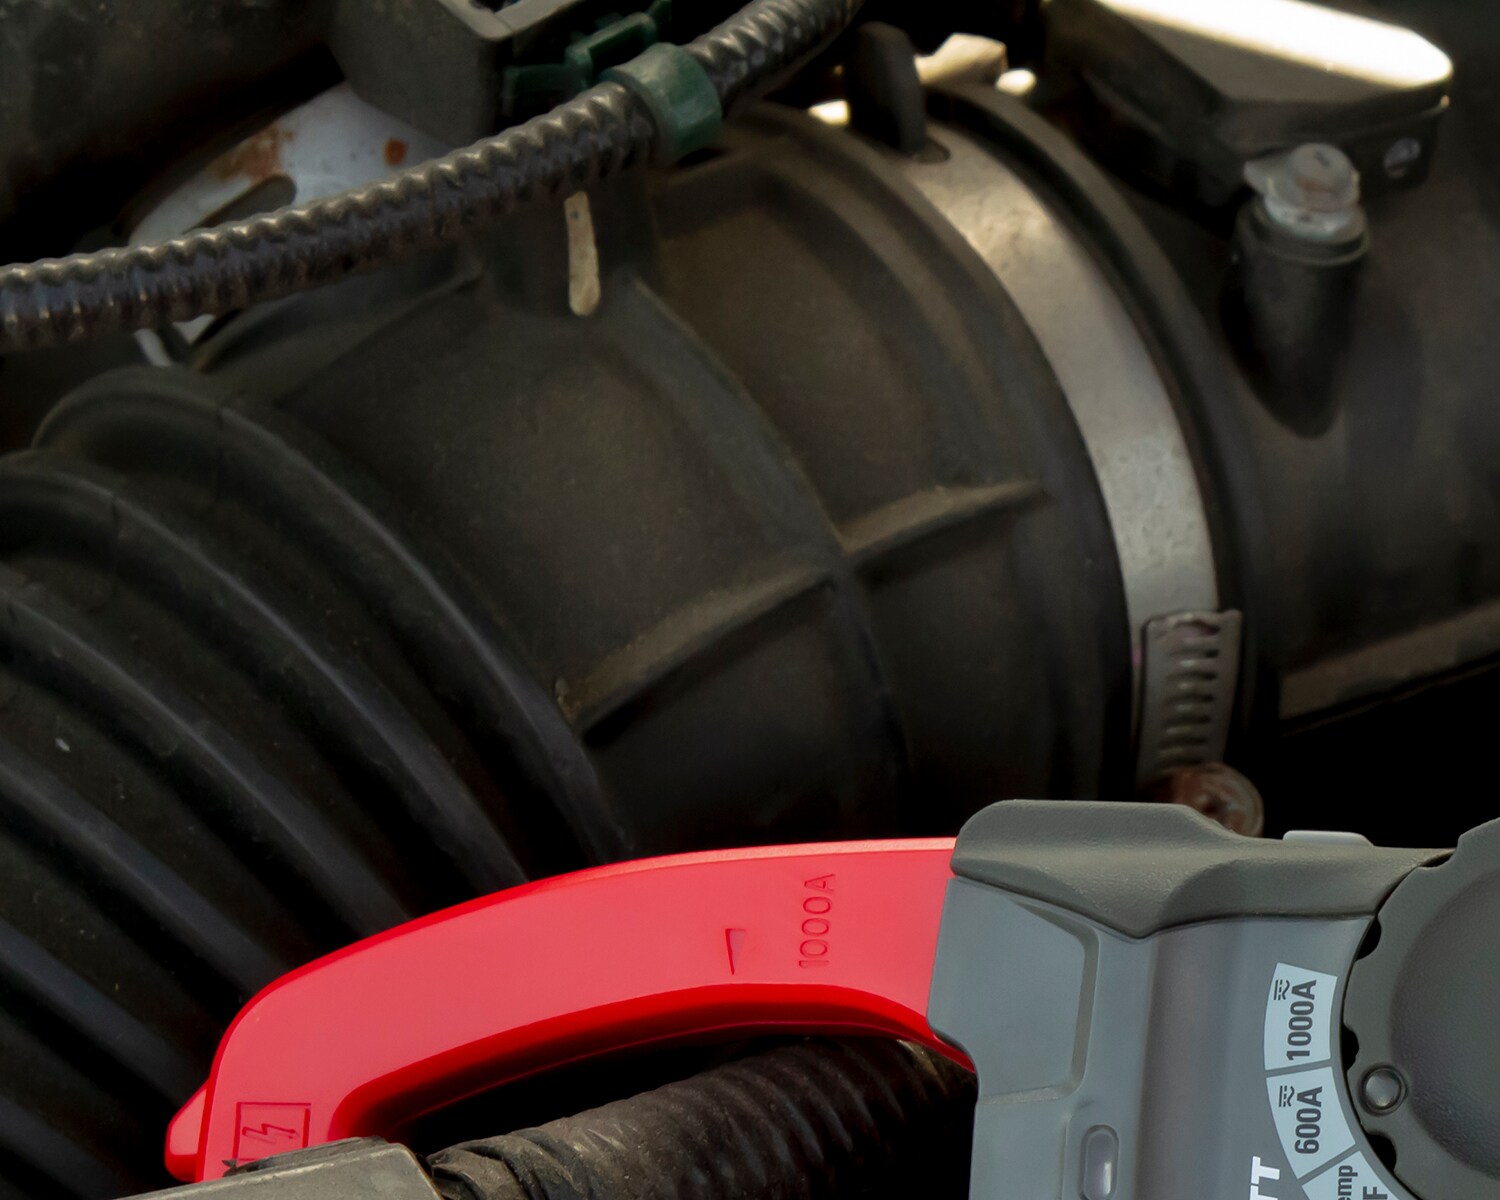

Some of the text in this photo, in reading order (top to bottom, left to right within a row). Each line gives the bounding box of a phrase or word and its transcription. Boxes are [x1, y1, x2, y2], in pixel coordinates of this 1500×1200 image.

[798, 873, 836, 969] 1000A
[1286, 979, 1317, 1061] 1000A
[1294, 1086, 1323, 1155] 600A
